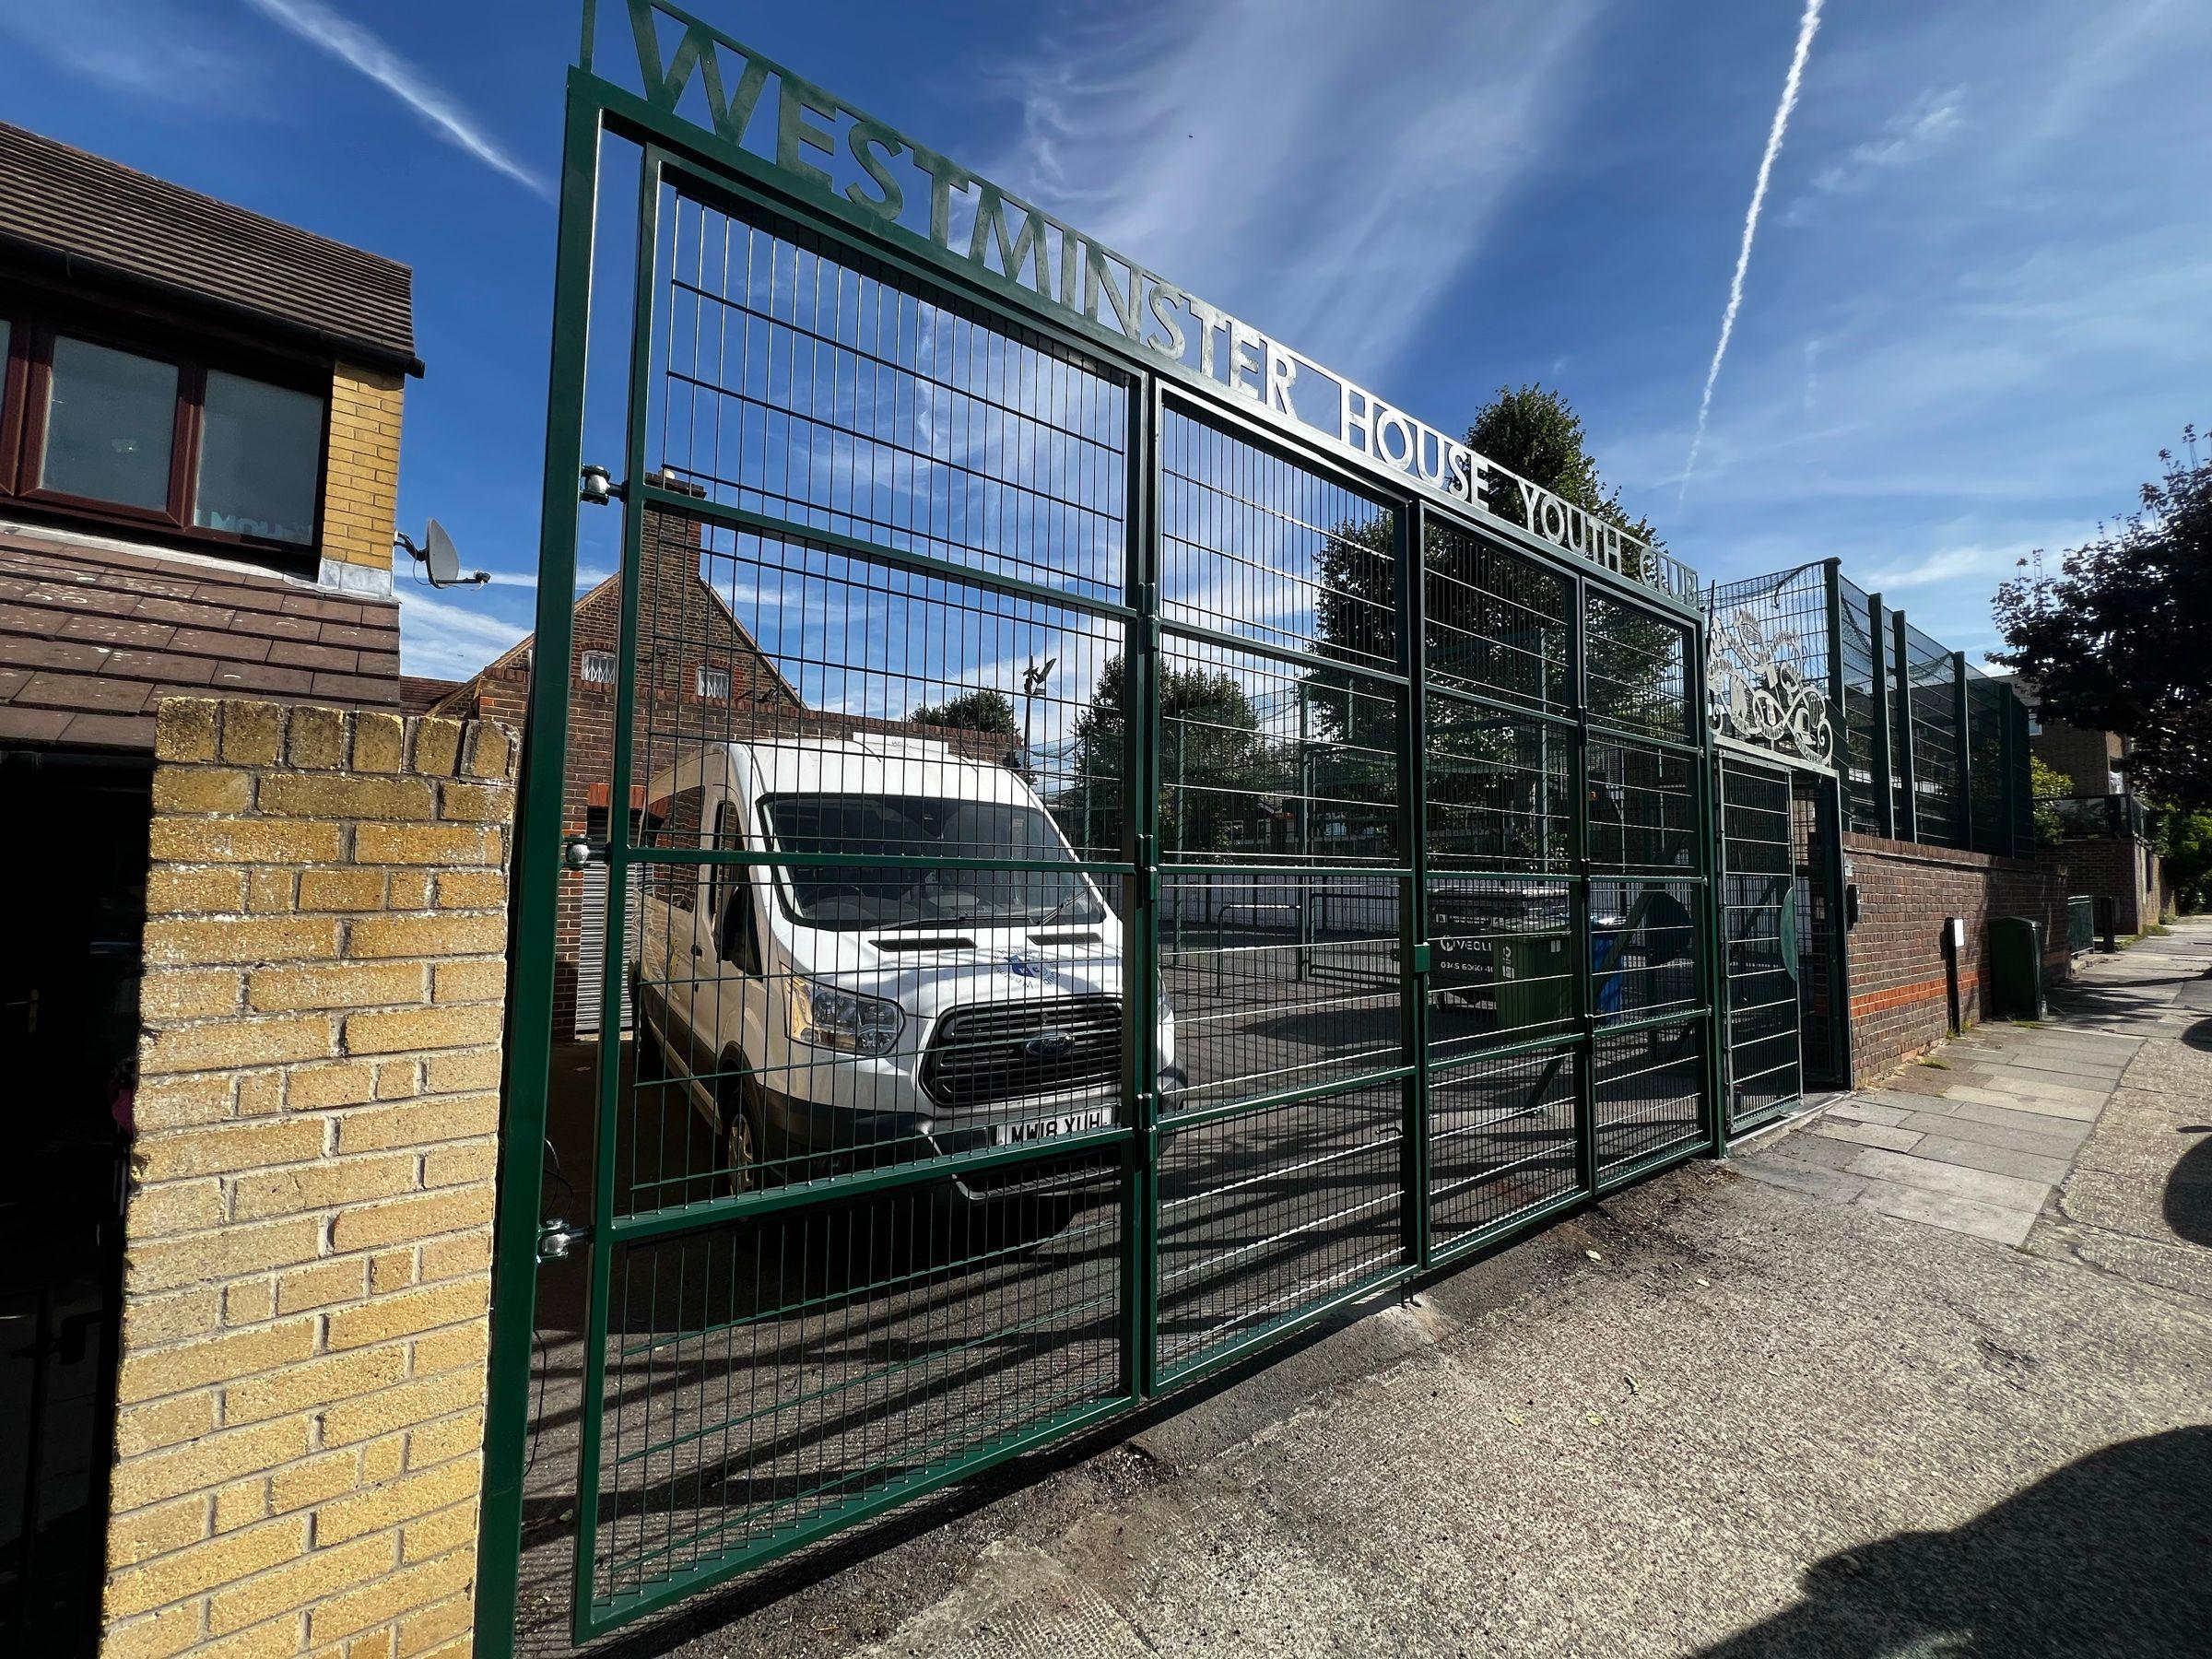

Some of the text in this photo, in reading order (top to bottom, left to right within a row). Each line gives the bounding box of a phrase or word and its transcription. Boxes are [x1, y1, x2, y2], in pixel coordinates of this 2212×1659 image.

[628, 0, 1698, 608] WESTMINSTER HOUSE YOUTH CLUB
[1456, 939, 1492, 952] VEOLI
